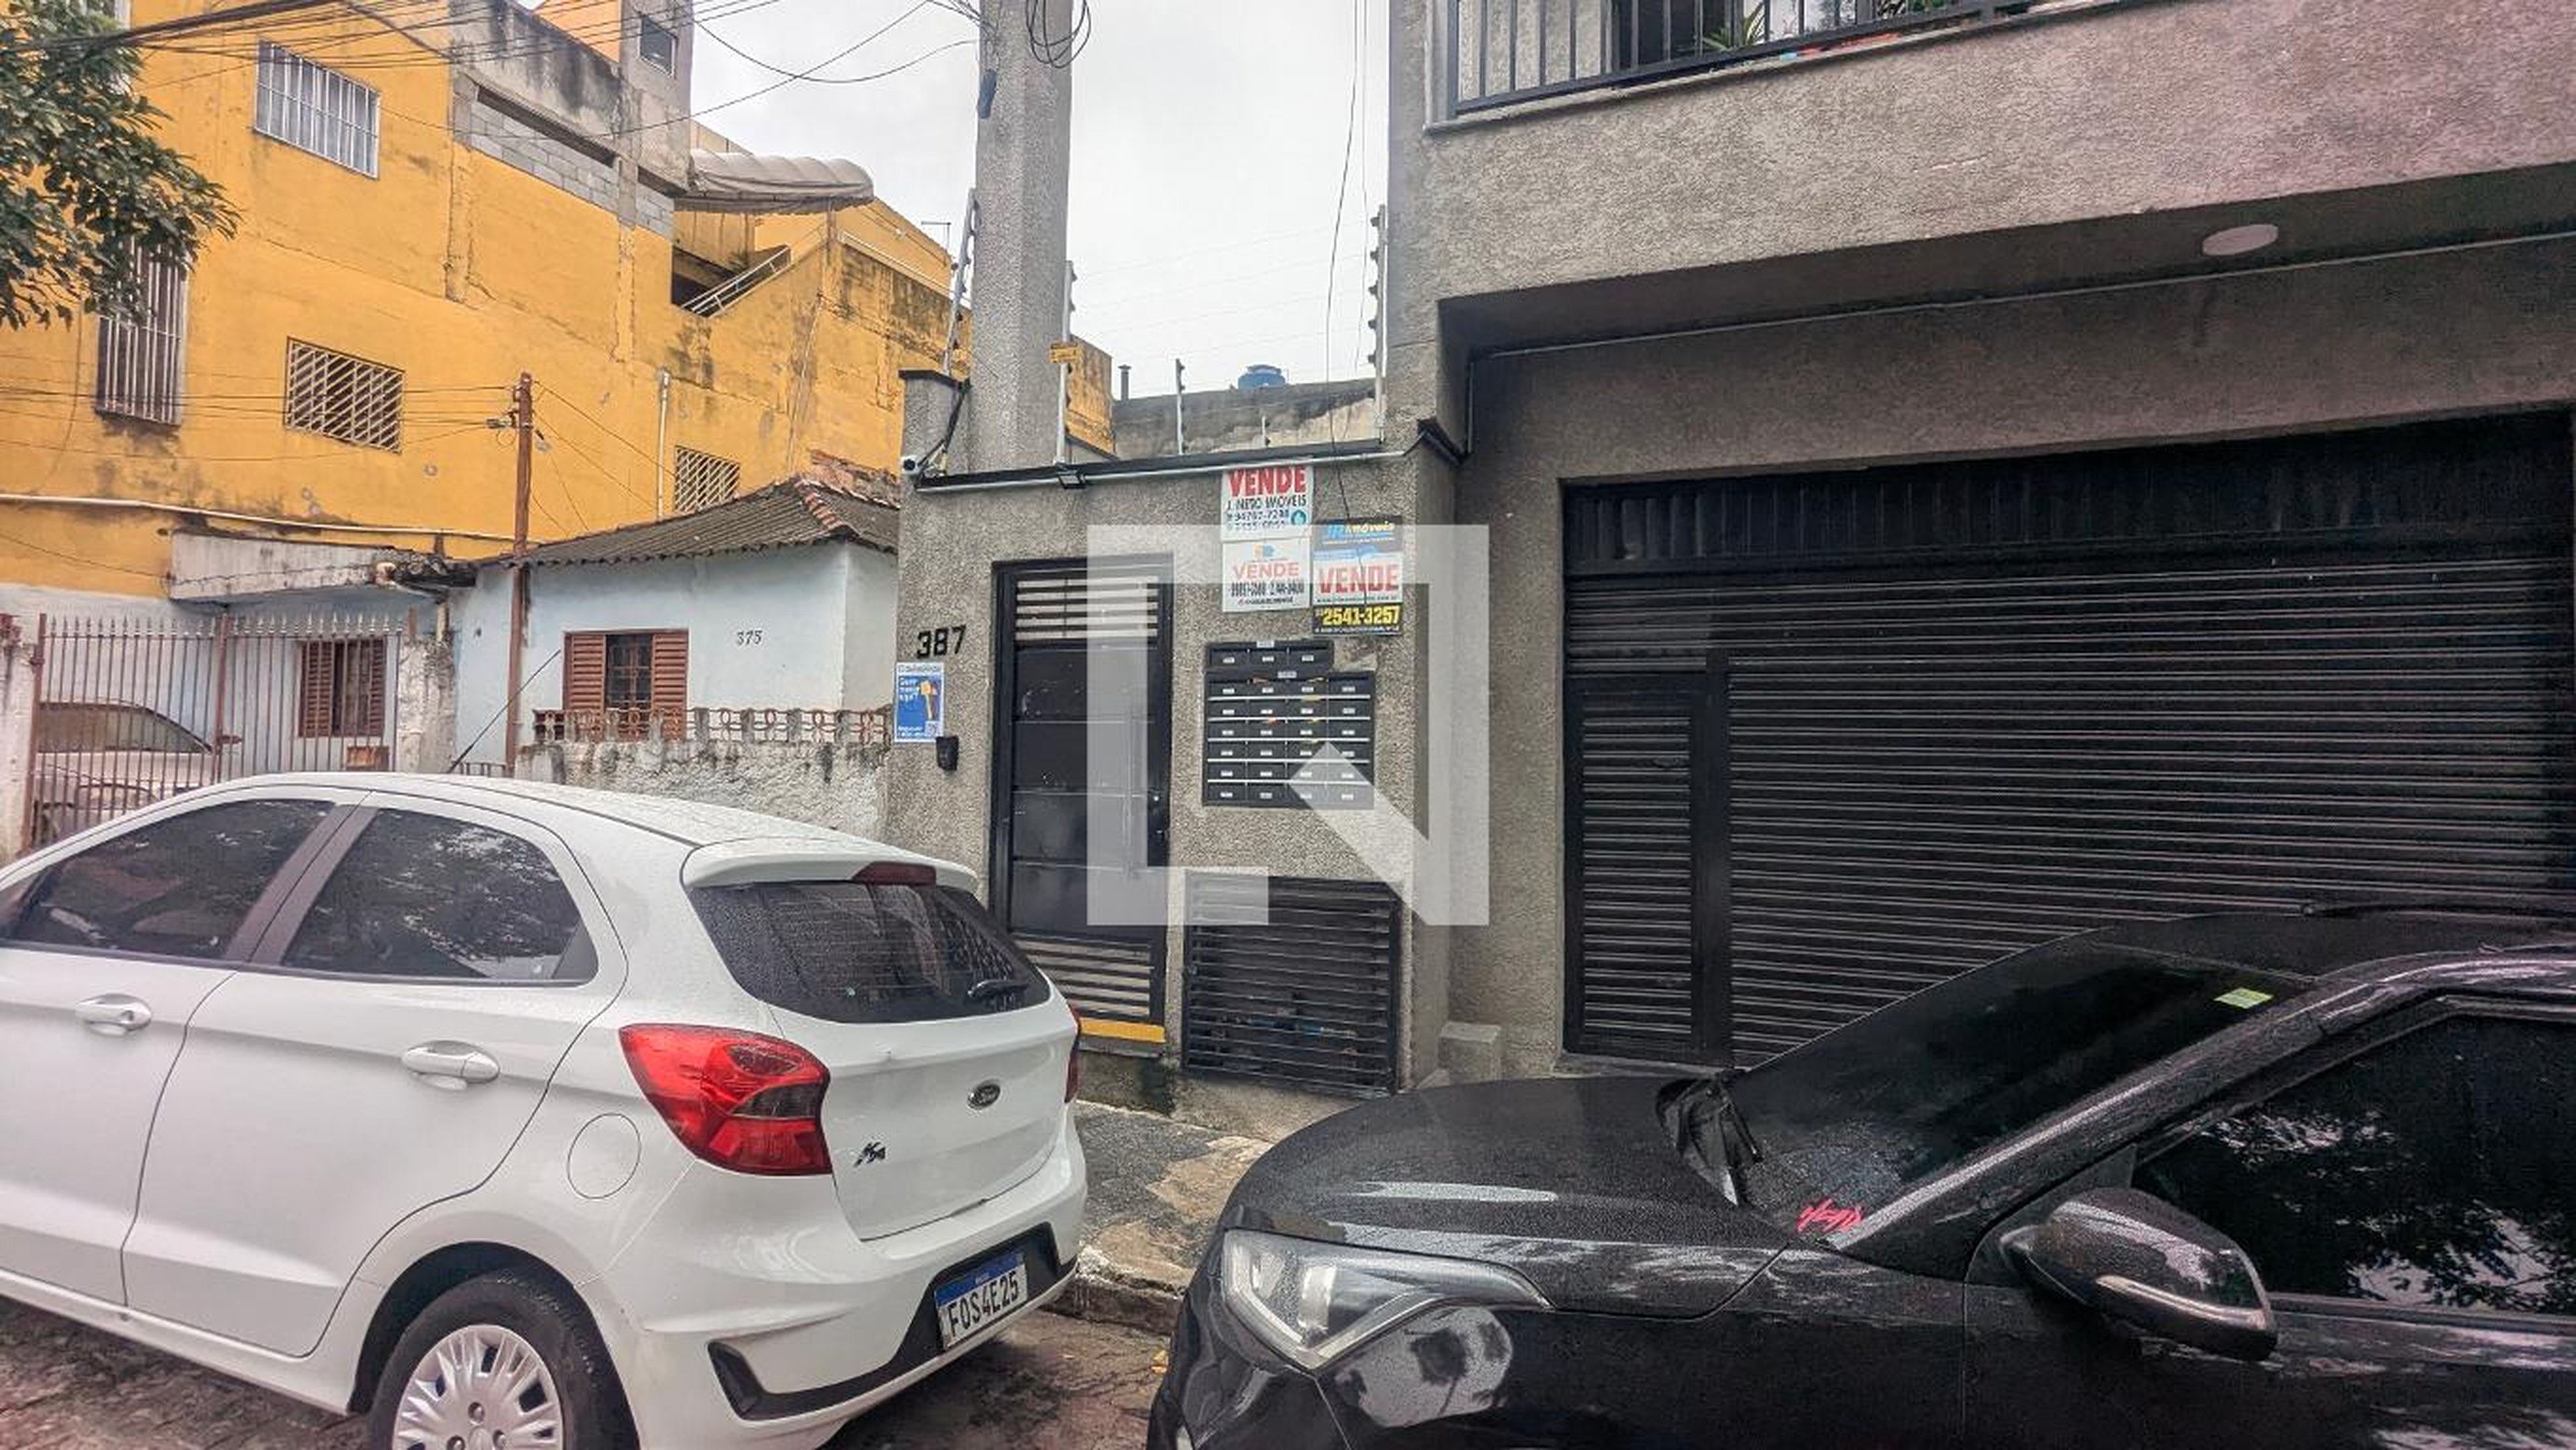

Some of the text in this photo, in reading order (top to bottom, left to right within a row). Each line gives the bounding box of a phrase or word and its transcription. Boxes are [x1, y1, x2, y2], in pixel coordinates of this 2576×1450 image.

[1229, 464, 1306, 497] VENDE
[1232, 562, 1299, 579] VENDE
[1319, 564, 1399, 593] VENDE
[1322, 605, 1400, 626] 2541-3257
[916, 625, 966, 659] 387
[947, 1270, 1020, 1337] FOS4E25
